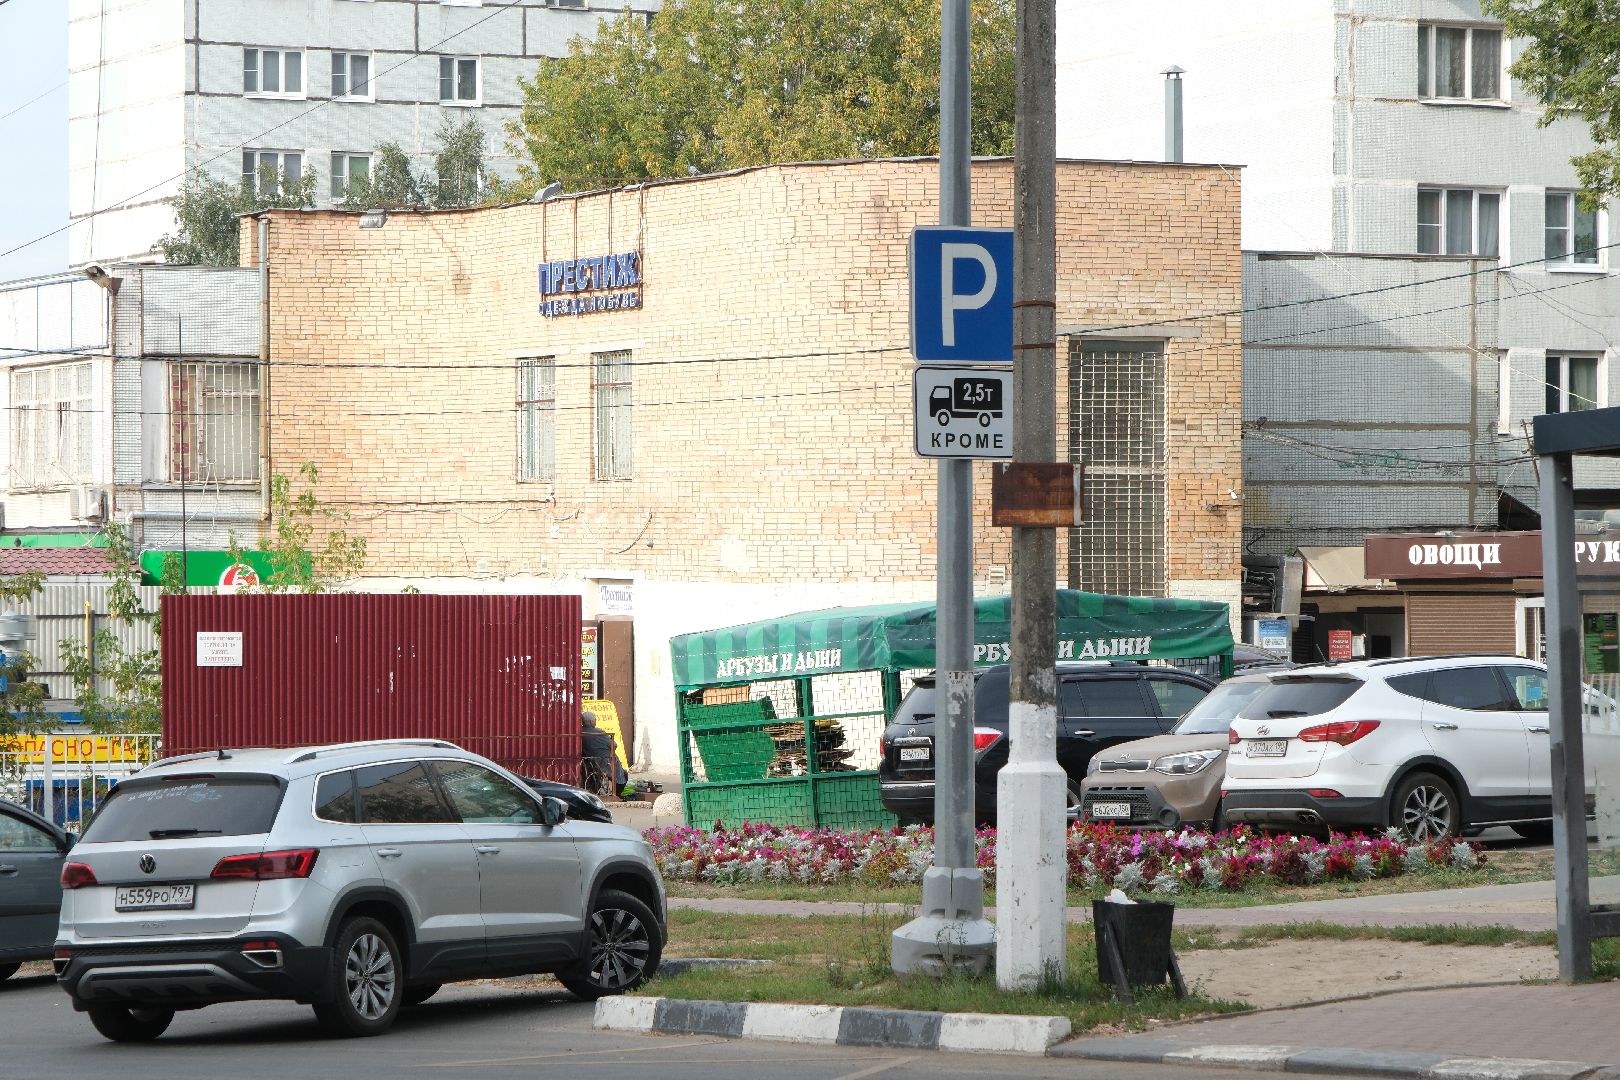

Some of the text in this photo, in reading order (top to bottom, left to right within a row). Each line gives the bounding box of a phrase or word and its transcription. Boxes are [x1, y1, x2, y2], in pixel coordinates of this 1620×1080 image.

[538, 250, 639, 294] ПРЕСТИЖ
[941, 242, 998, 347] P
[931, 432, 1004, 449] КРОМЕ
[1408, 541, 1620, 571] ОВОЩИ РУК
[716, 648, 841, 678] АРБУЗЫ И ДЫНИ
[974, 636, 1152, 662] РБУ И ДЫНИ
[120, 886, 191, 904] Н559РО 797
